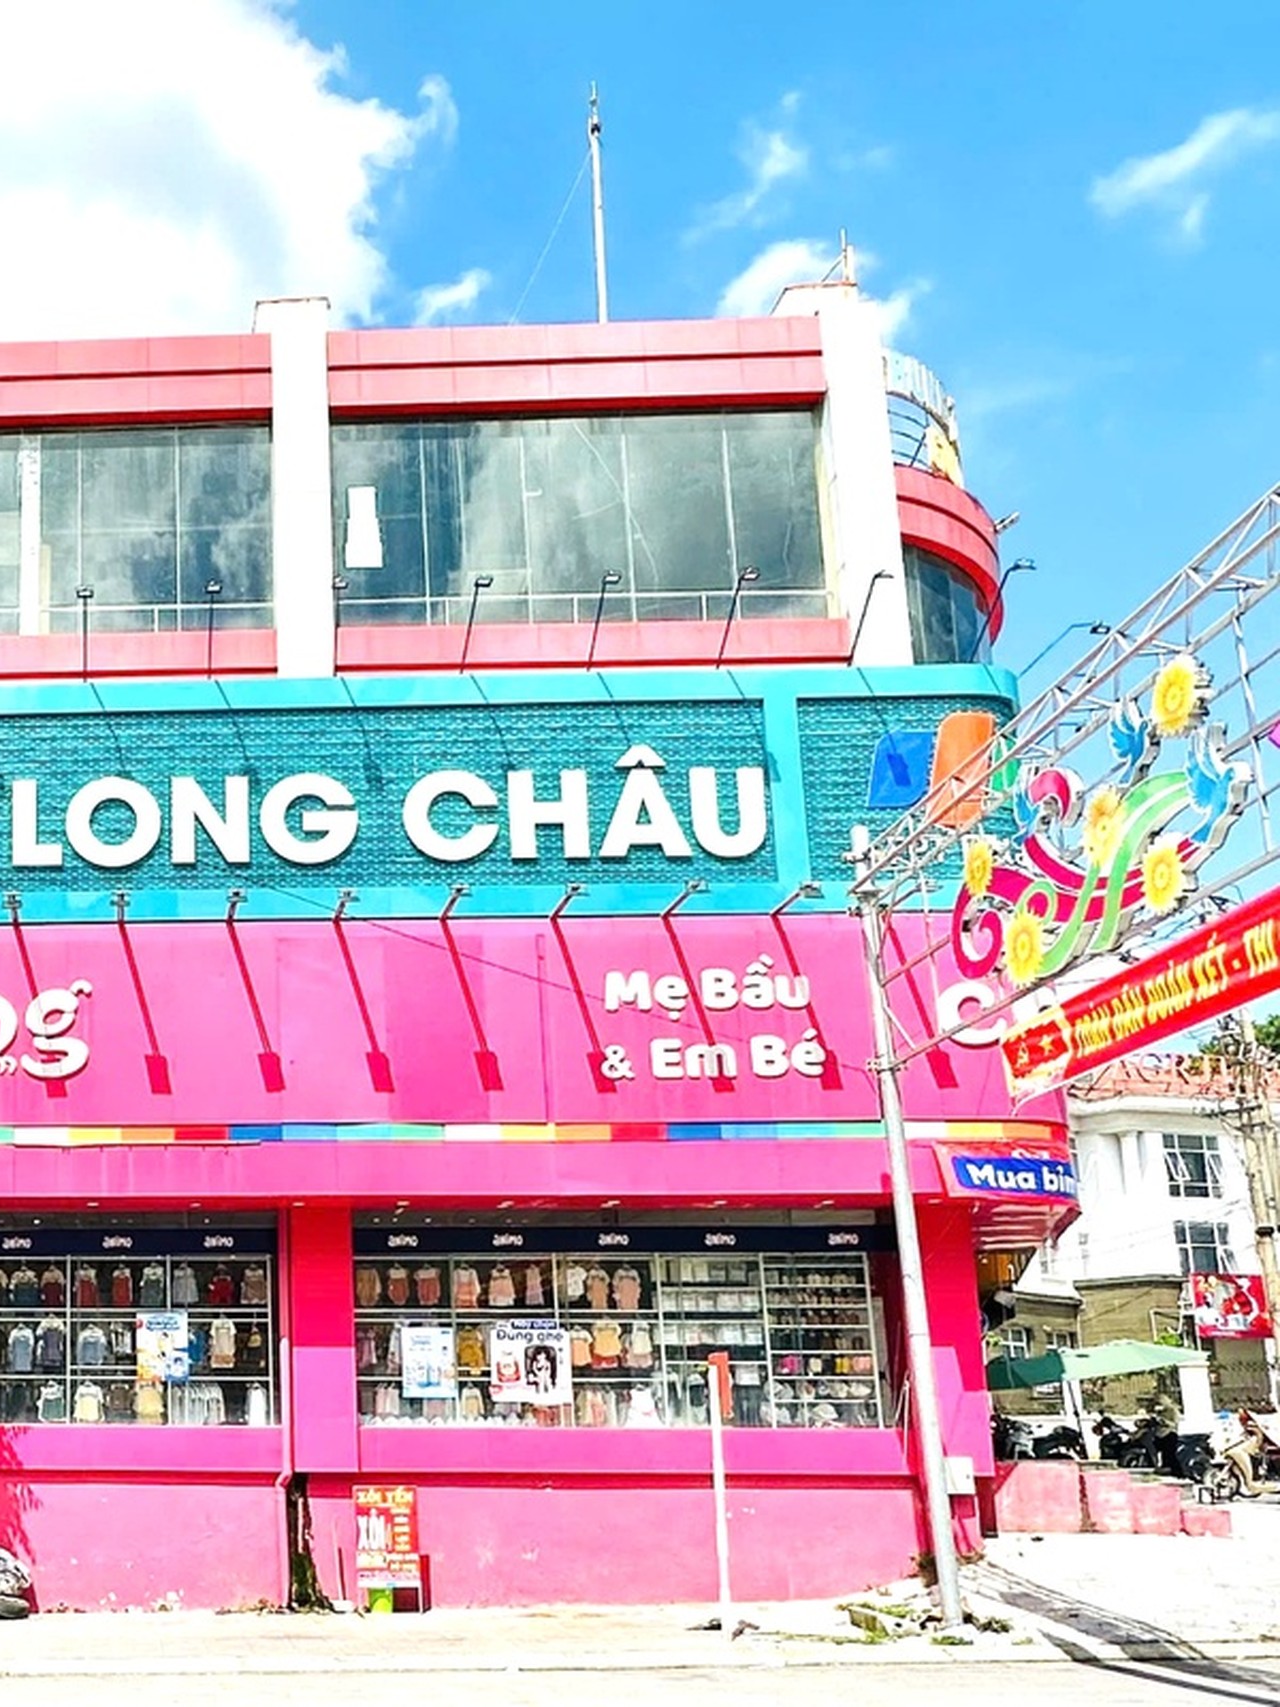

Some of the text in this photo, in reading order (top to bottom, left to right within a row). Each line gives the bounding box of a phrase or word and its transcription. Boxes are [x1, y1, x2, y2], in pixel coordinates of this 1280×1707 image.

[11, 773, 359, 868] LONG
[402, 745, 768, 863] CHÂU
[605, 953, 810, 1021] Mẹ Bầu
[601, 1028, 827, 1080] & Em Bé
[966, 1163, 1037, 1190] Mua
